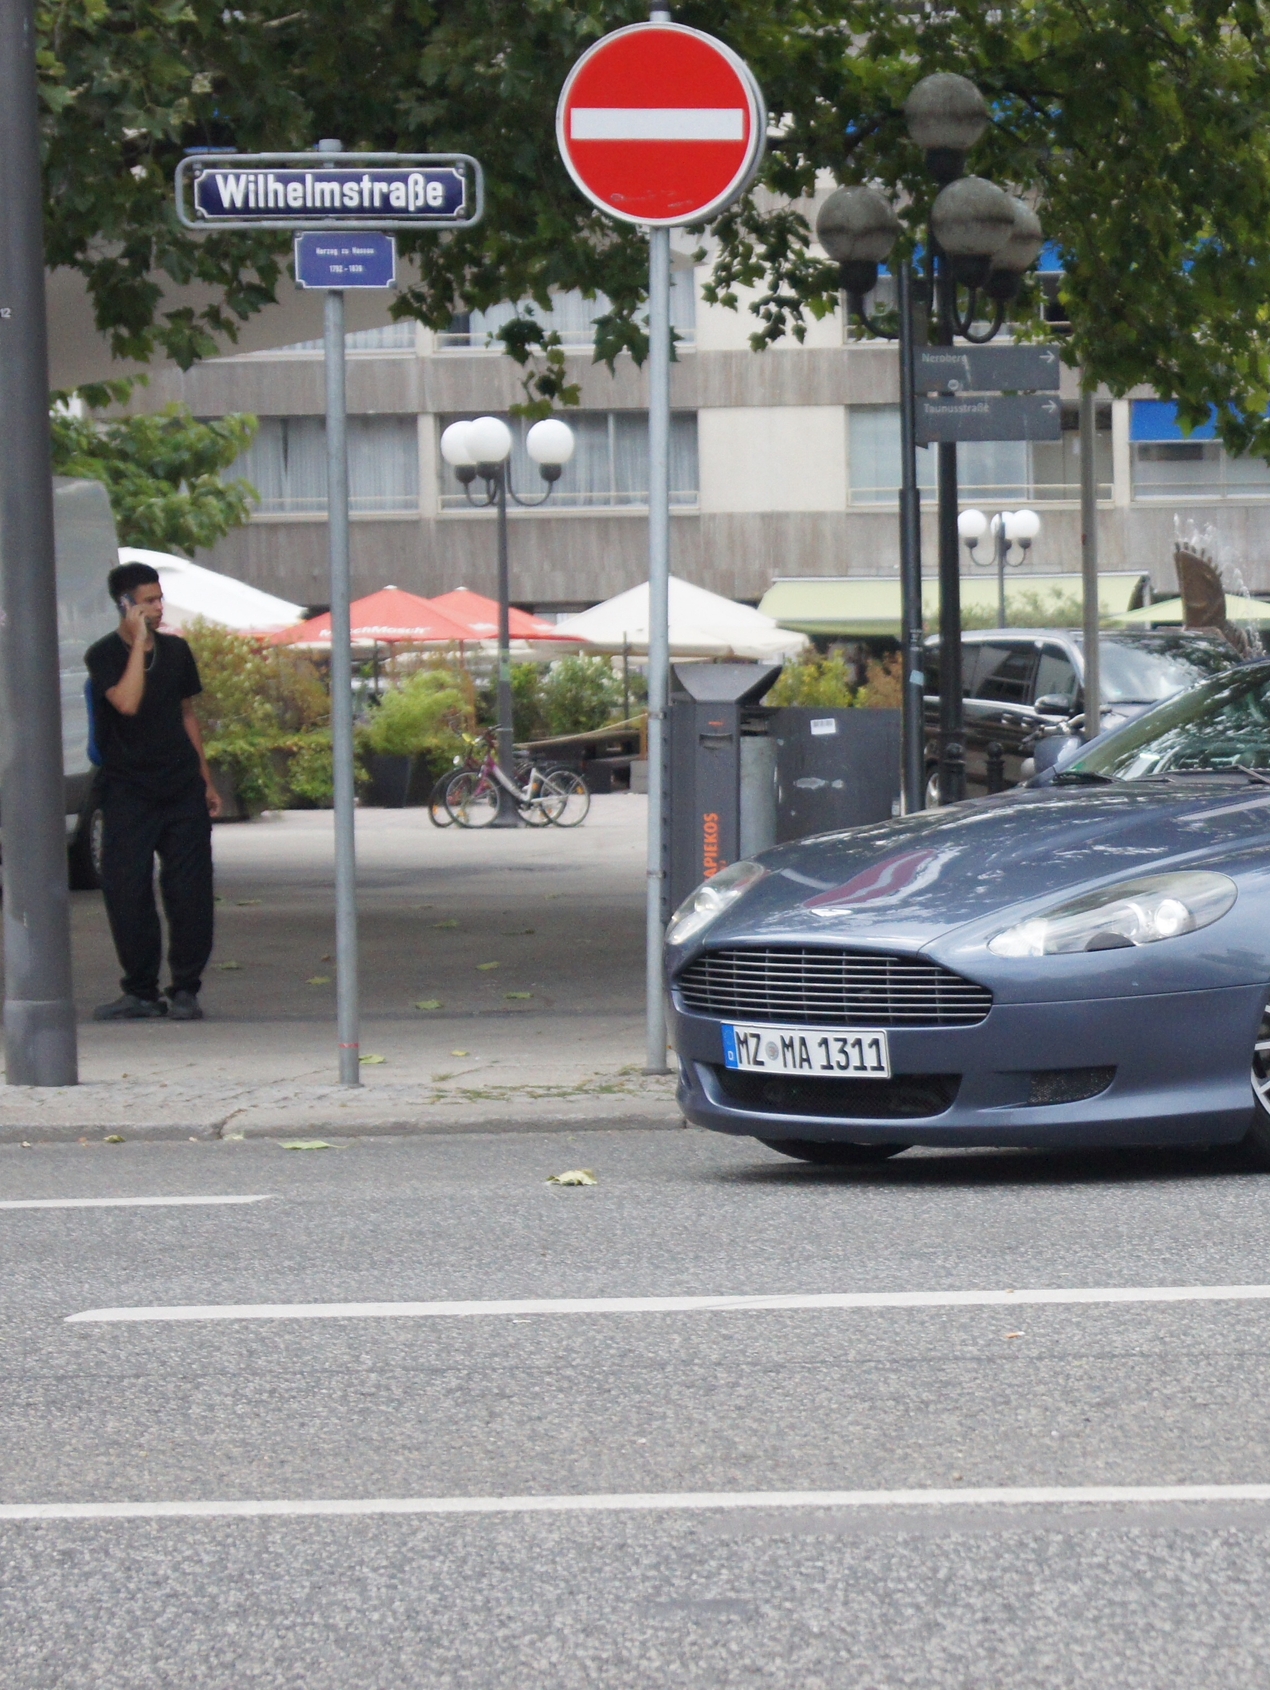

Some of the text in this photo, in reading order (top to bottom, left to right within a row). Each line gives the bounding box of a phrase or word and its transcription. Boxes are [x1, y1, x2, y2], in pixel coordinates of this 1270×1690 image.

[214, 172, 444, 212] Wilhelmstraße
[921, 353, 967, 366] Neroberg
[924, 402, 990, 414] Taunusstraße
[727, 1050, 735, 1061] D
[735, 1031, 886, 1072] MZ MA 1311
